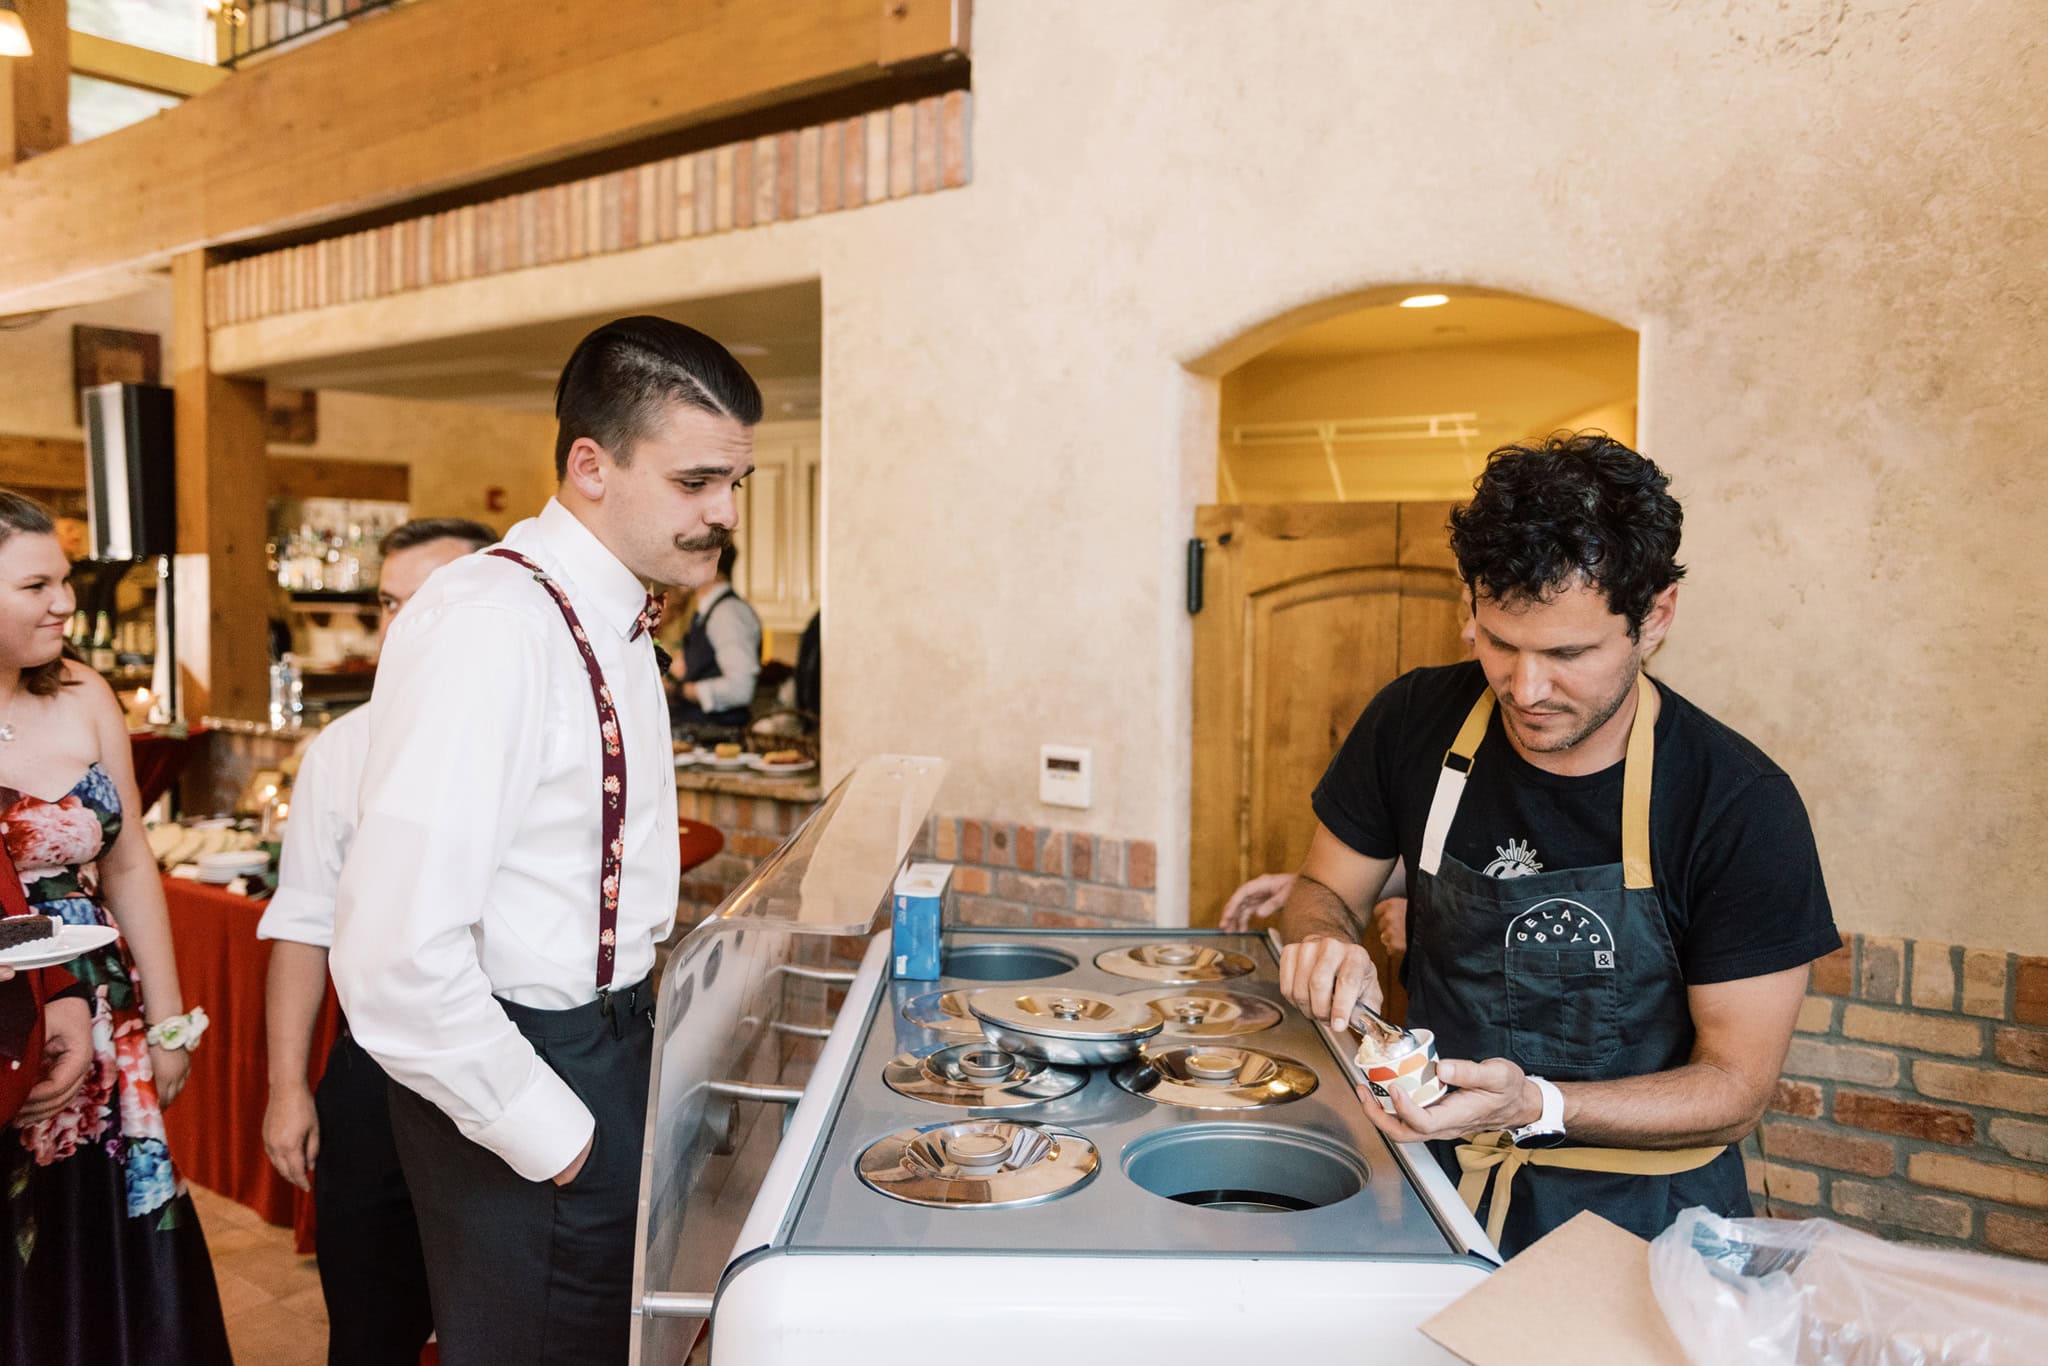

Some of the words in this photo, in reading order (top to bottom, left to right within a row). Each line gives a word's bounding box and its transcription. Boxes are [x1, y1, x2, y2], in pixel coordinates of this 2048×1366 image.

[1516, 909, 1601, 944] GELATO
[1534, 924, 1583, 944] BOY
[1598, 953, 1610, 966] &
